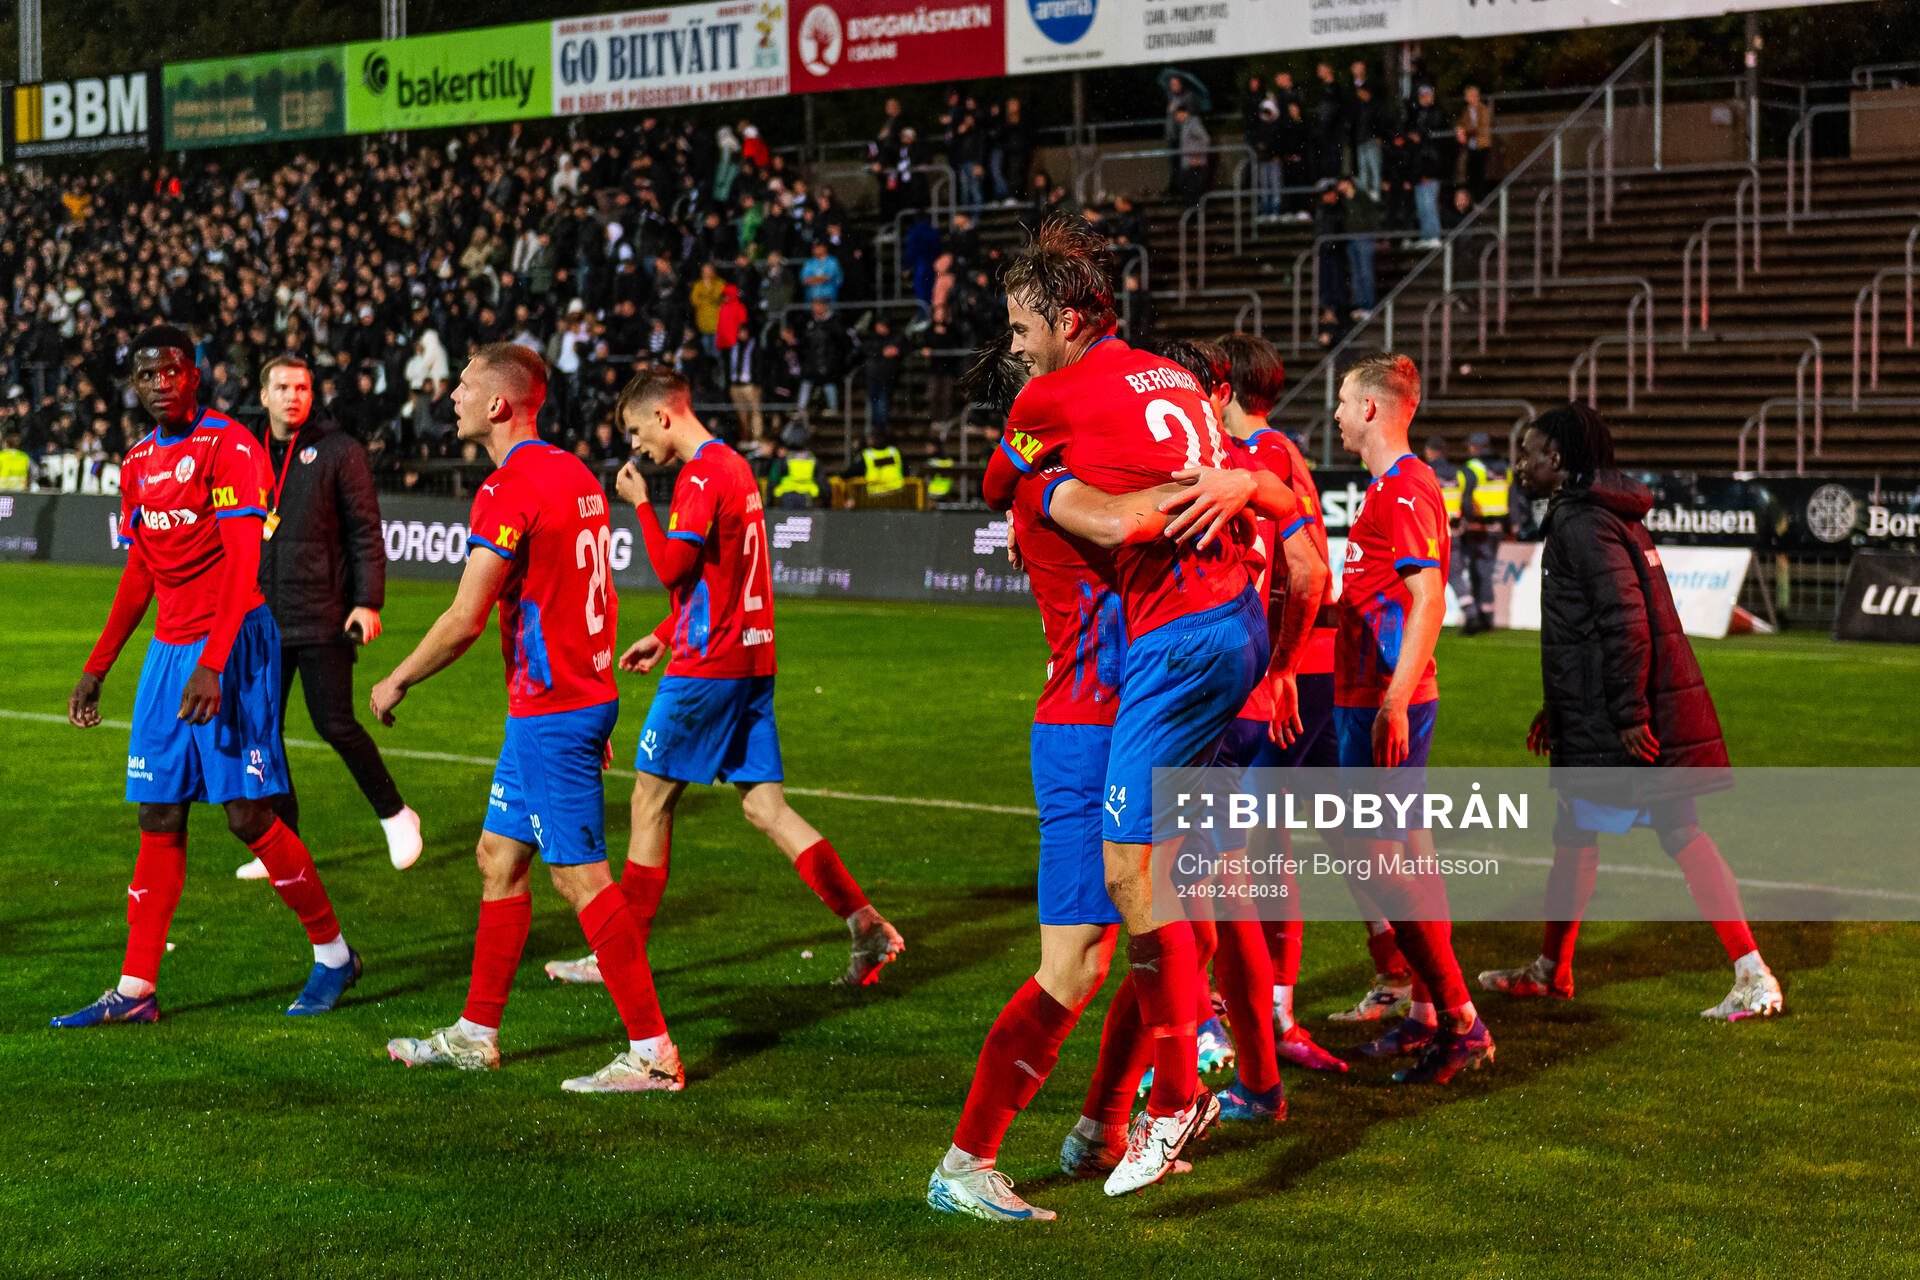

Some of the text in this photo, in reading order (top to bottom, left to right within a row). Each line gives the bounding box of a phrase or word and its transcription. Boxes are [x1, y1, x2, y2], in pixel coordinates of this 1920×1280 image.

[560, 18, 742, 86] GO BILTVÄTT
[397, 58, 535, 109] bakertilly
[43, 72, 148, 141] BBM
[1010, 428, 1043, 464] XXL
[141, 504, 171, 530] kea
[577, 494, 605, 518] OLSSON
[1321, 482, 1366, 527] st
[1644, 503, 1757, 534] tahusen
[1867, 505, 1920, 537] Bor
[380, 520, 471, 564] ORGO
[576, 525, 610, 636] 20
[1668, 570, 1730, 590] entral
[1861, 584, 1920, 616] un
[644, 728, 657, 744] 21
[250, 749, 262, 765] 22
[1109, 784, 1127, 804] 24
[529, 813, 541, 829] 20
